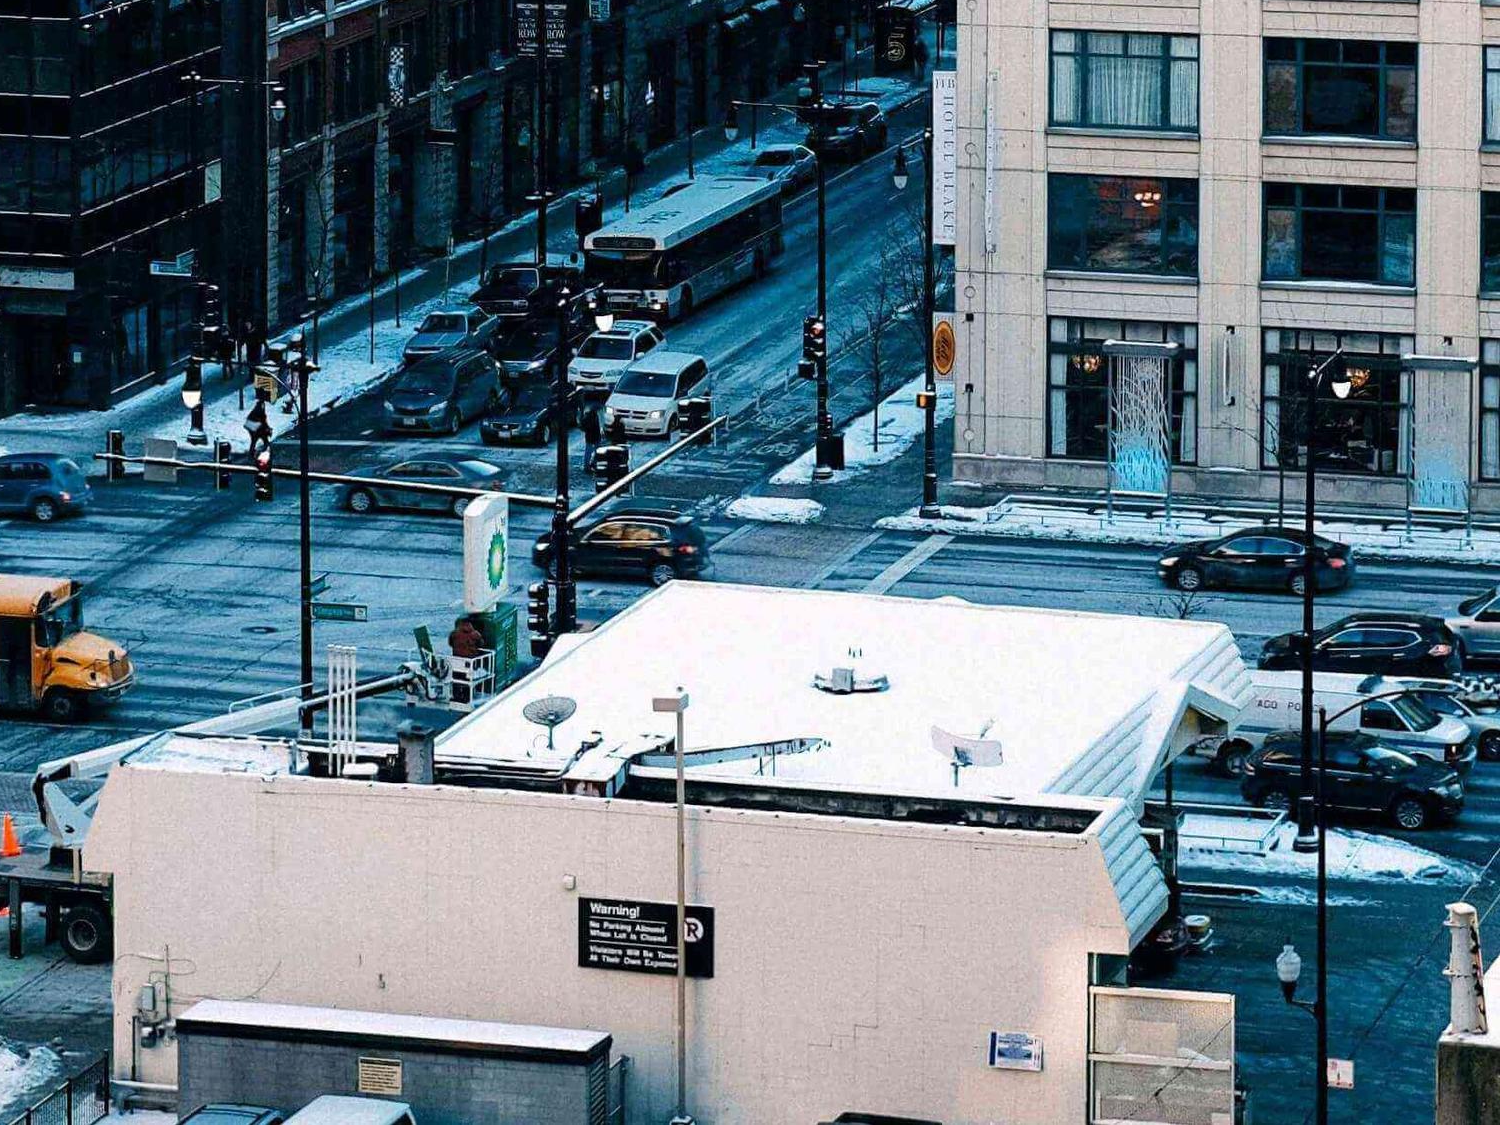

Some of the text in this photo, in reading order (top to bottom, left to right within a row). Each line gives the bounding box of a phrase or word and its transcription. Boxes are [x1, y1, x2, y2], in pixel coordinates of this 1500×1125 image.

[943, 95, 955, 234] HOTEL BLAKE
[589, 902, 640, 919] Warning!
[603, 921, 632, 933] Parking
